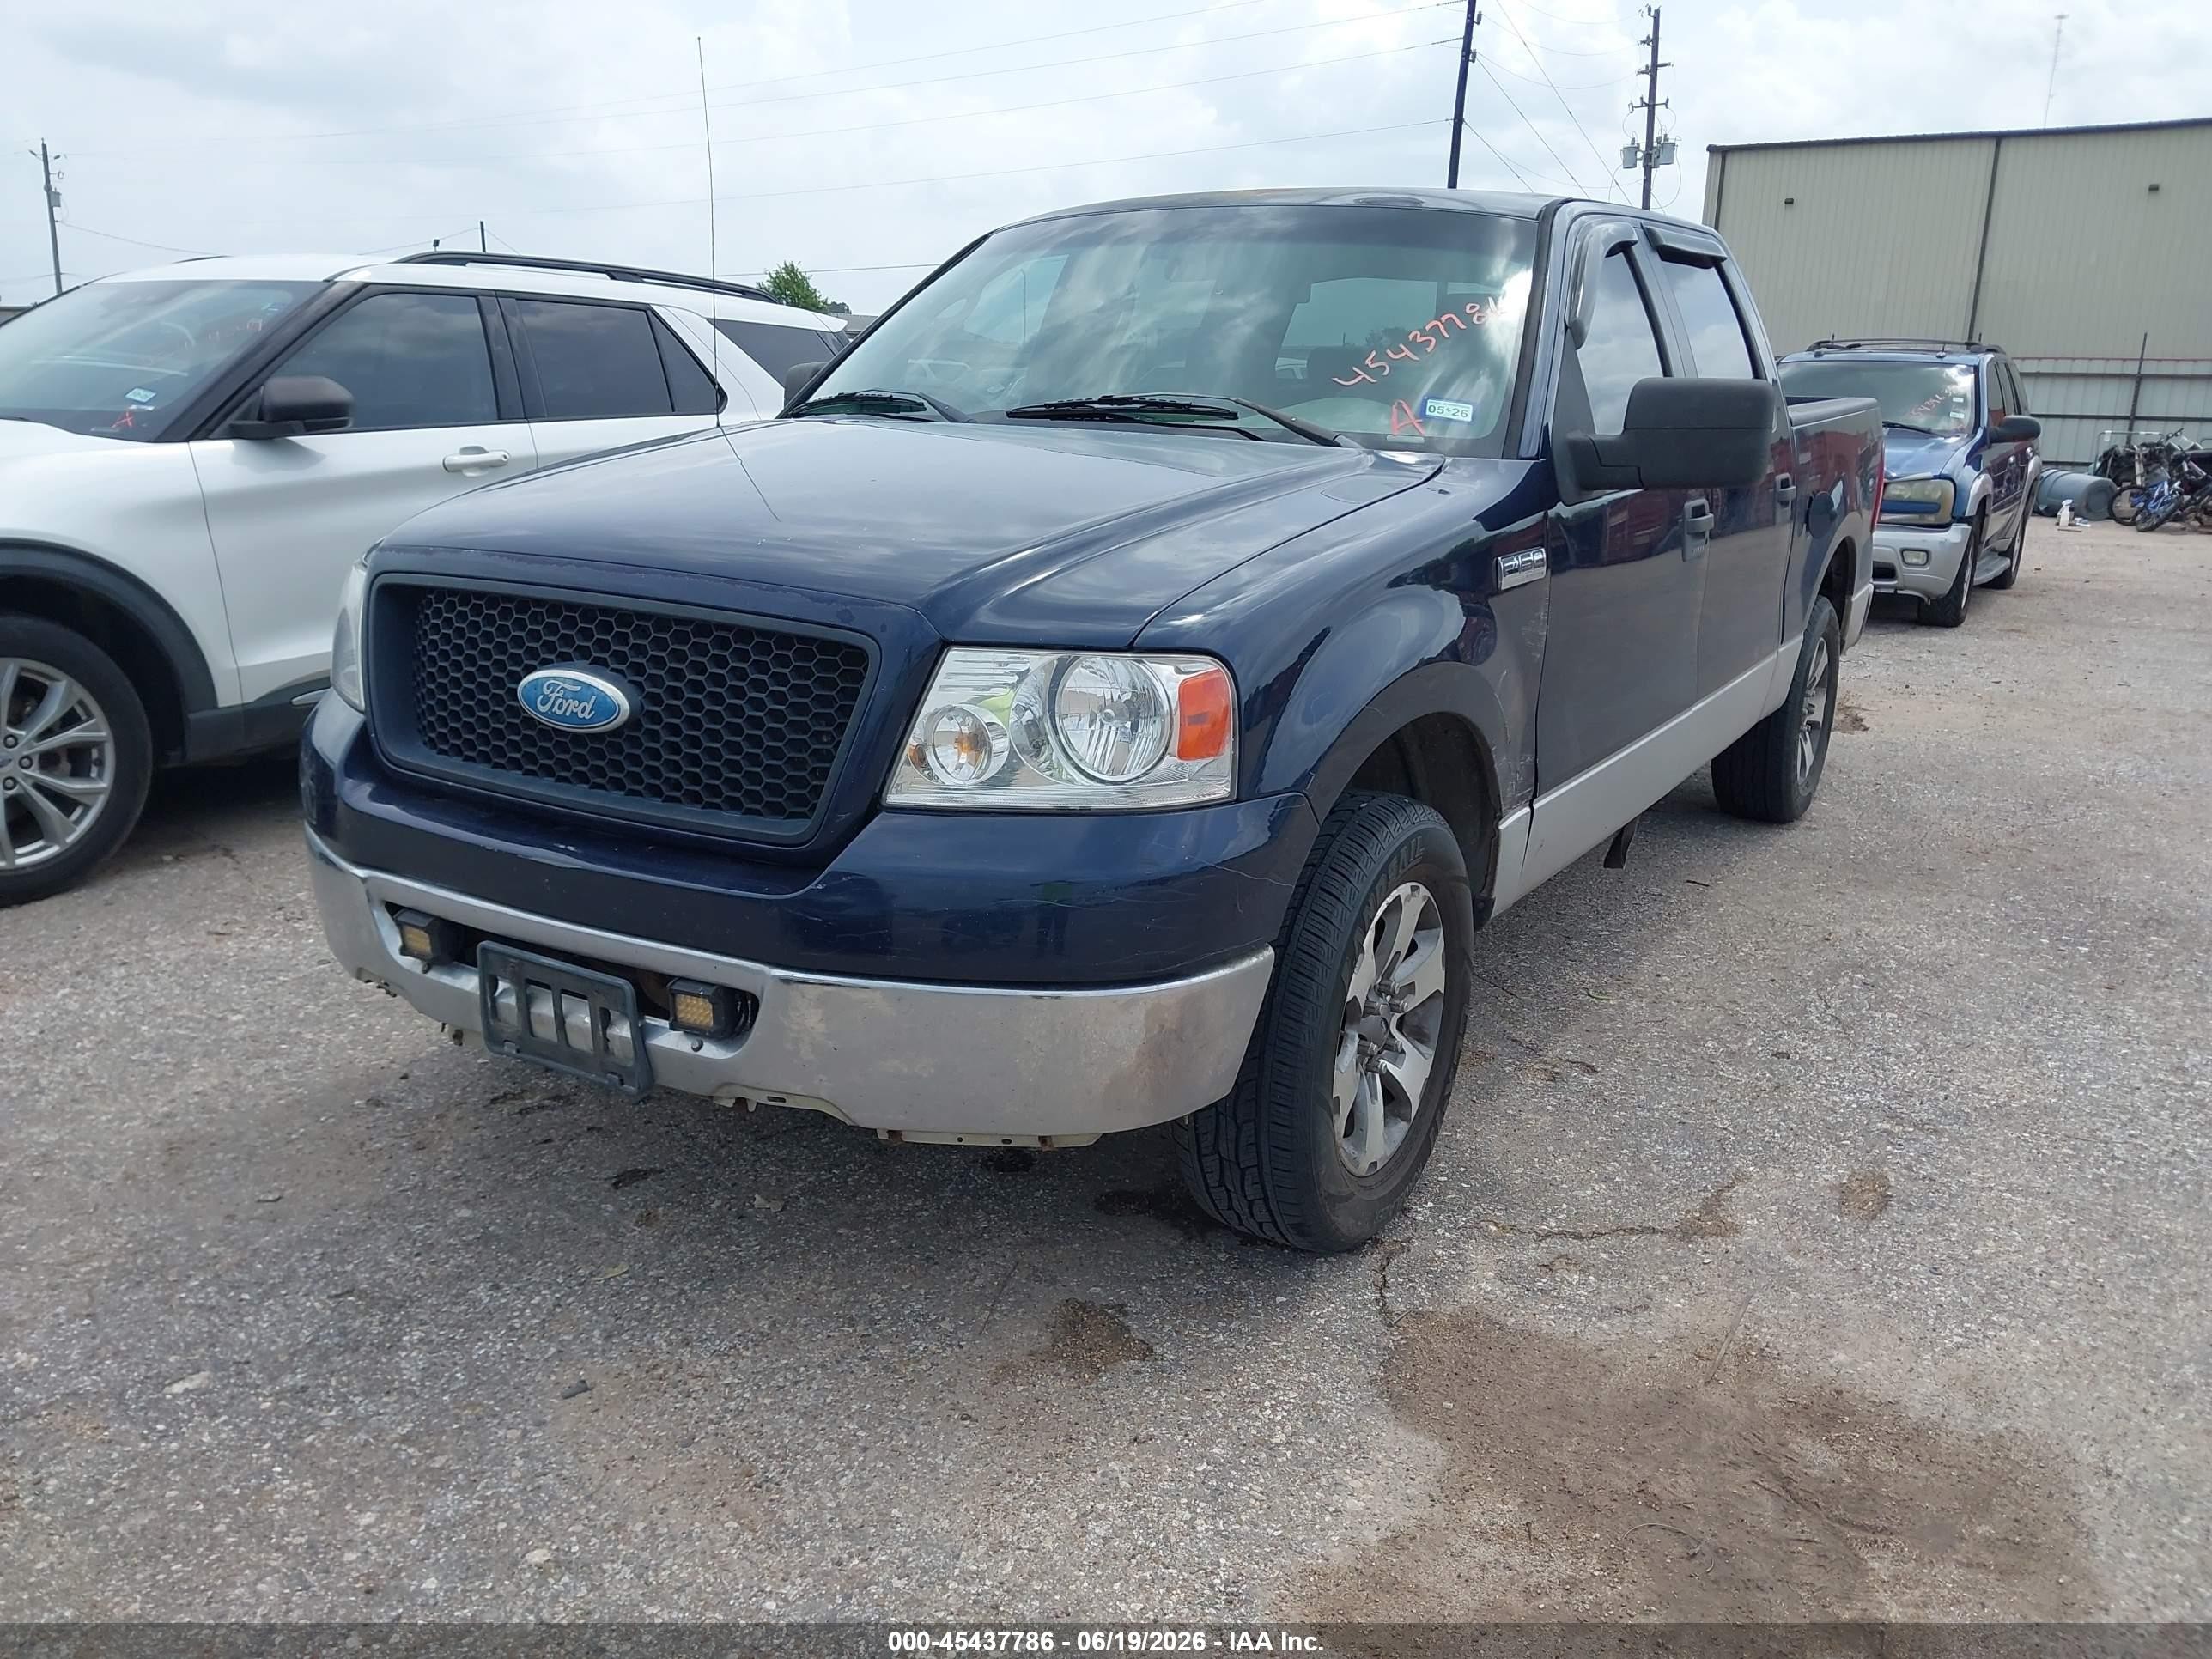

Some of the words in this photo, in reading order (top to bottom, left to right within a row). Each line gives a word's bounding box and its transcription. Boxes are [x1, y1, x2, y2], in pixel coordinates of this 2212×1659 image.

[1390, 399, 1425, 436] A
[1428, 404, 1444, 415] 05
[1451, 407, 1468, 418] 26
[536, 679, 598, 720] Ford
